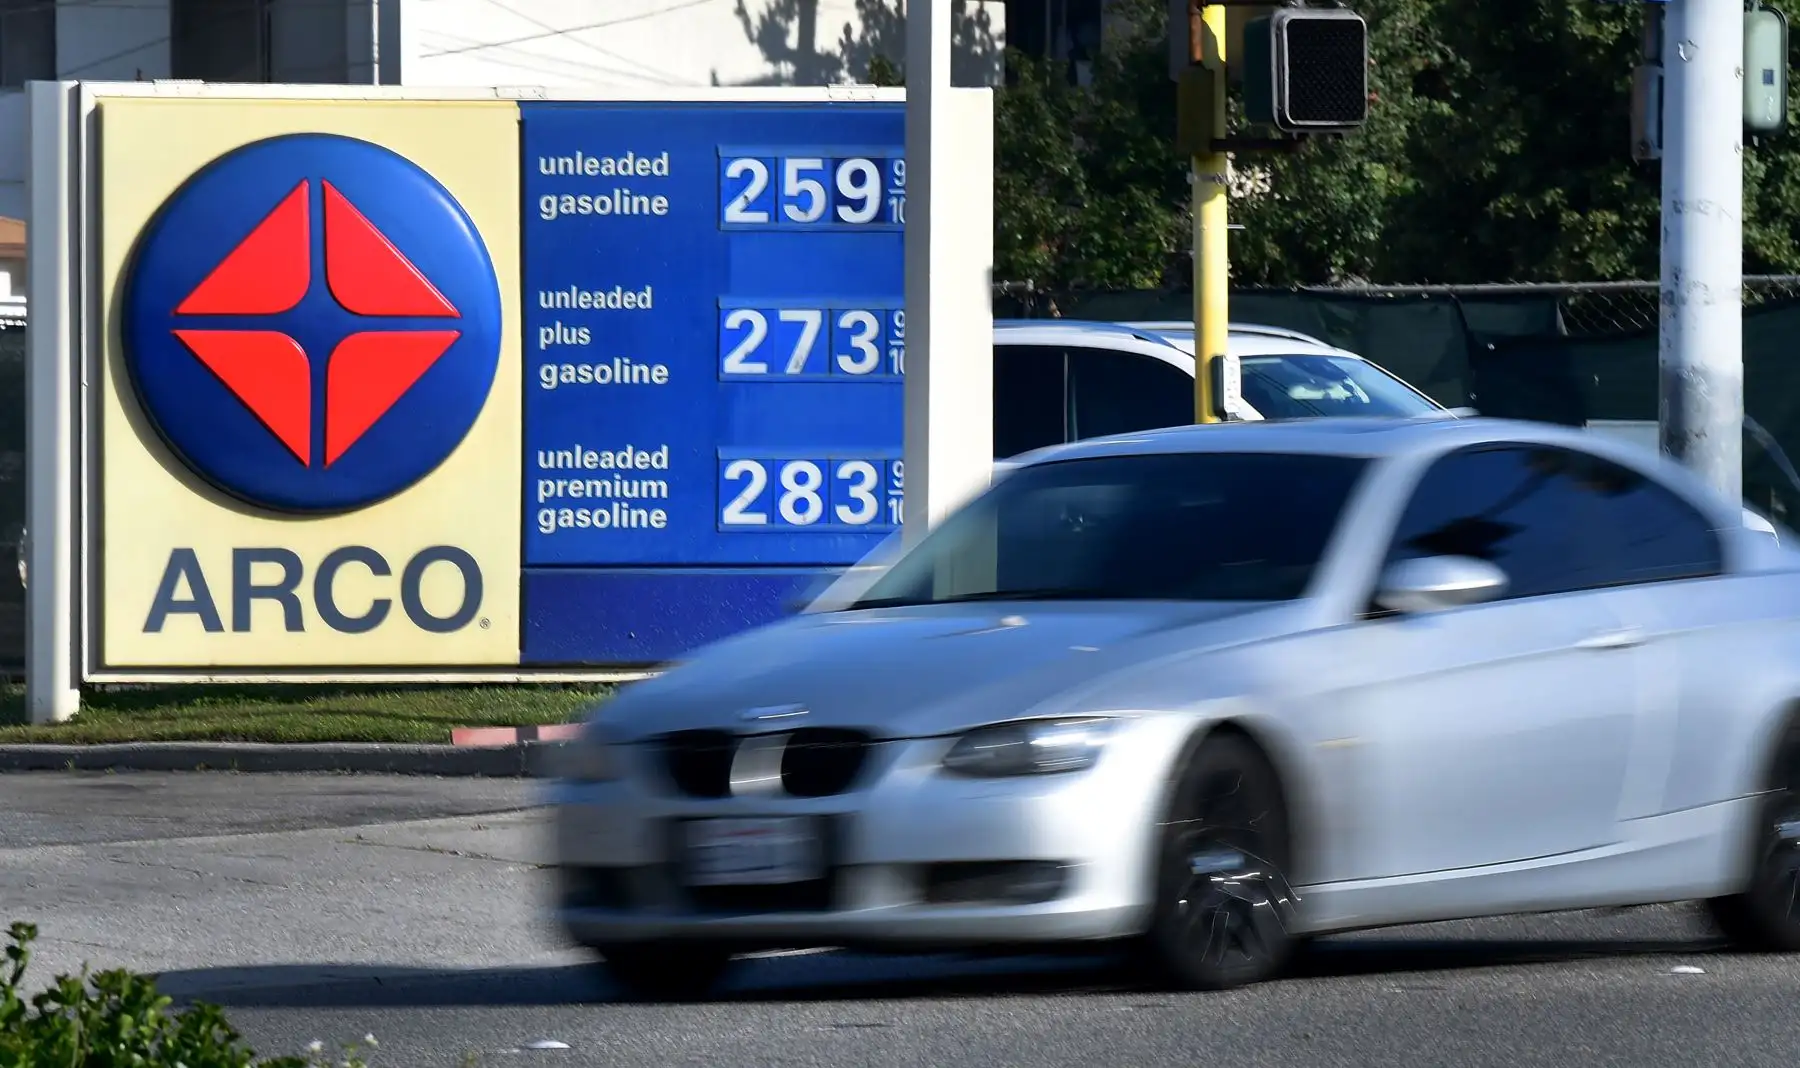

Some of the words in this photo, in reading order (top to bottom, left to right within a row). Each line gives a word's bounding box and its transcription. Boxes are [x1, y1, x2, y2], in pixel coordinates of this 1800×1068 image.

[539, 151, 669, 177] unleaded
[539, 188, 669, 221] gasoline
[725, 158, 881, 224] 259
[540, 285, 652, 310] unleaded
[540, 321, 591, 350] plus
[724, 309, 879, 375] 273
[540, 357, 669, 390] gasoline
[538, 444, 669, 470] unleaded
[538, 474, 668, 503] premium
[723, 459, 878, 526] 283
[538, 502, 668, 534] gasoline
[143, 545, 483, 633] ARCO
